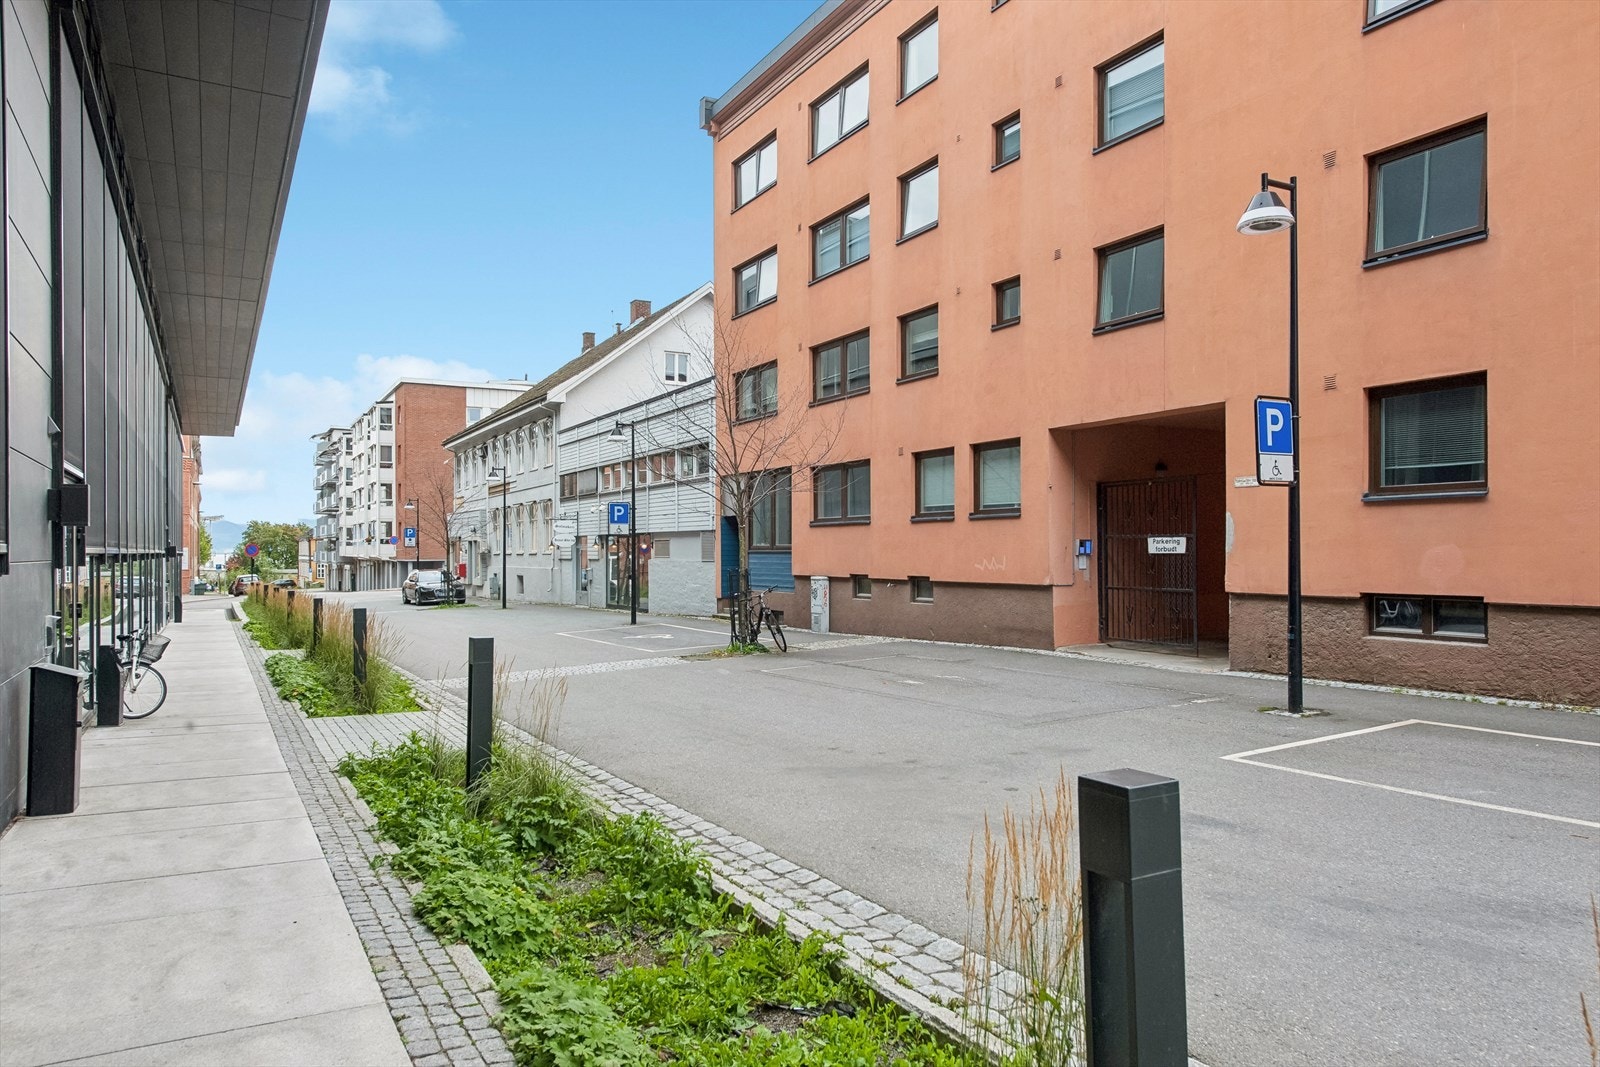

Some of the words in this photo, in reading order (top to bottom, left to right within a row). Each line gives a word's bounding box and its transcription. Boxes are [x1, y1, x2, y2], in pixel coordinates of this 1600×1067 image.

[1266, 408, 1284, 447] P
[614, 506, 625, 521] P
[407, 529, 413, 537] P
